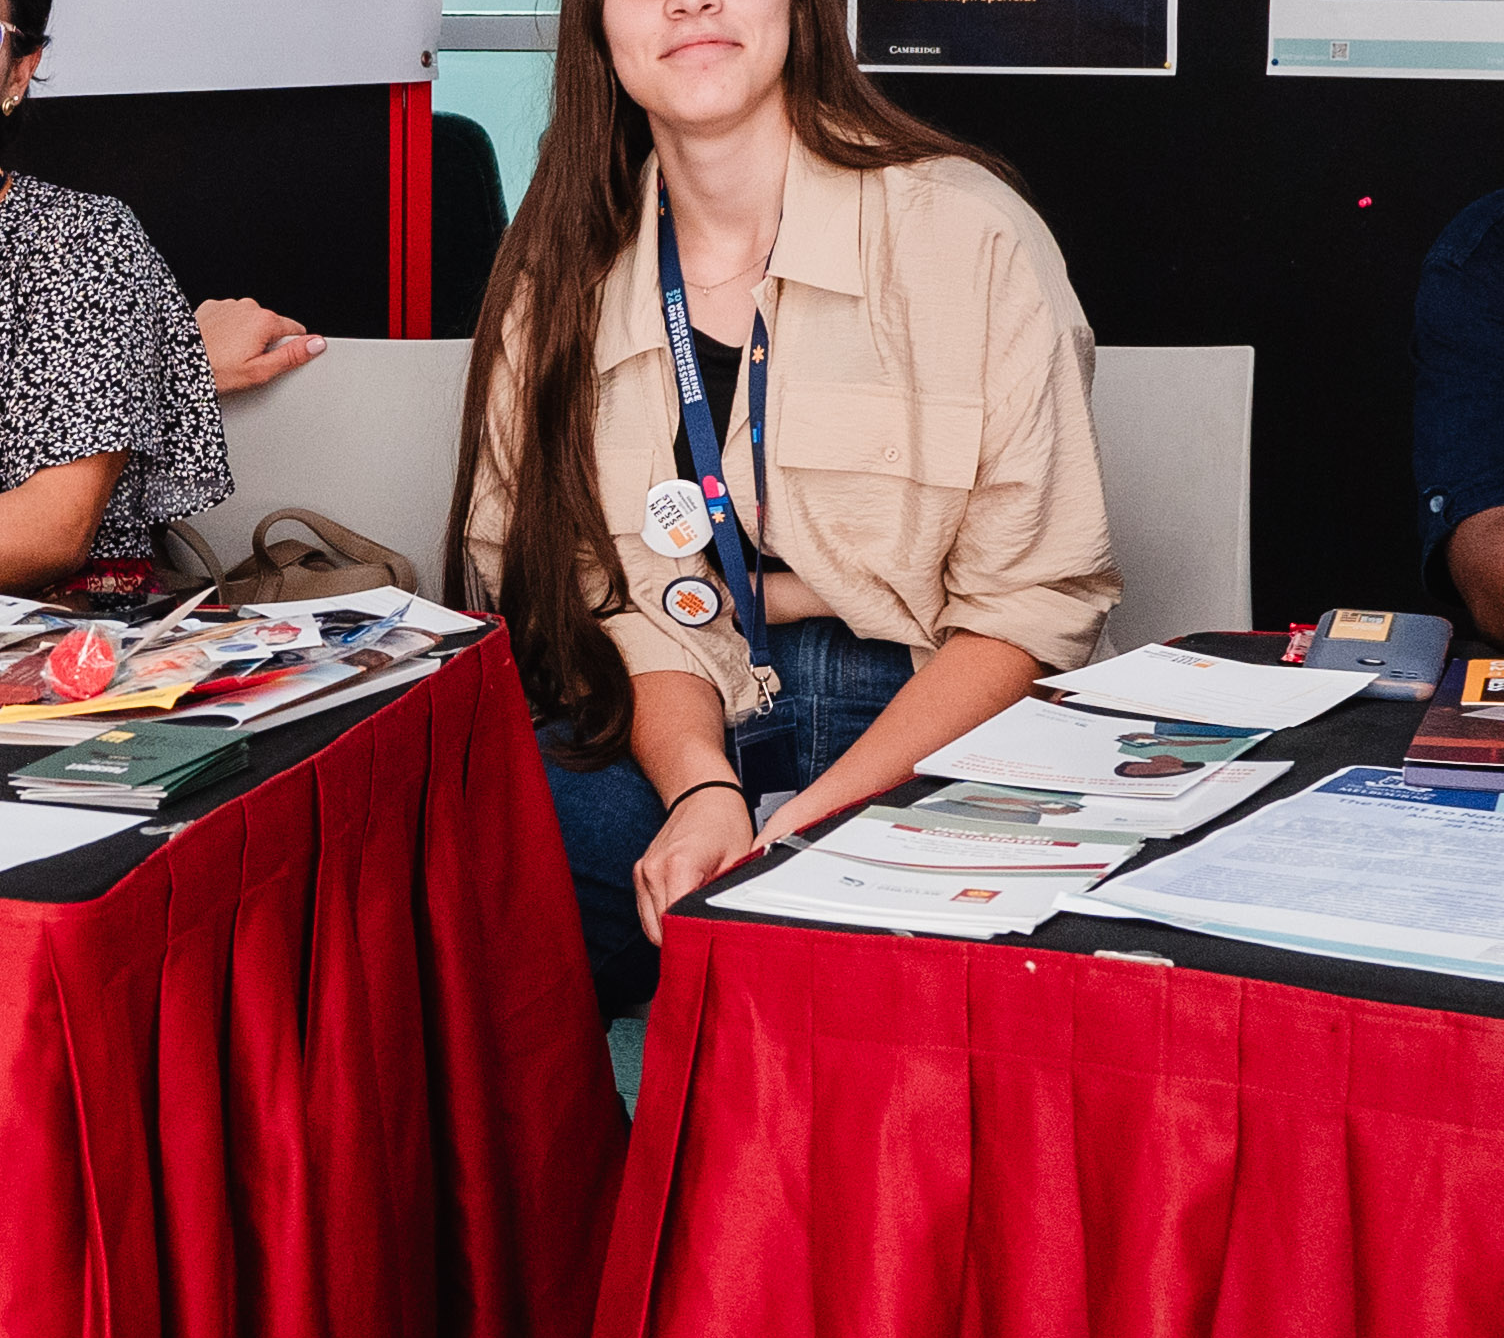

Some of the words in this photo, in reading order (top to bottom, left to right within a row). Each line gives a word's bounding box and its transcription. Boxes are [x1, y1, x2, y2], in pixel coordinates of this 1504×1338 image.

[889, 45, 941, 54] CAMBRIDGE
[668, 305, 676, 321] ON
[670, 321, 693, 404] STATELESSNESS
[676, 301, 688, 337] WORLD
[682, 337, 702, 401] CONFERENCE
